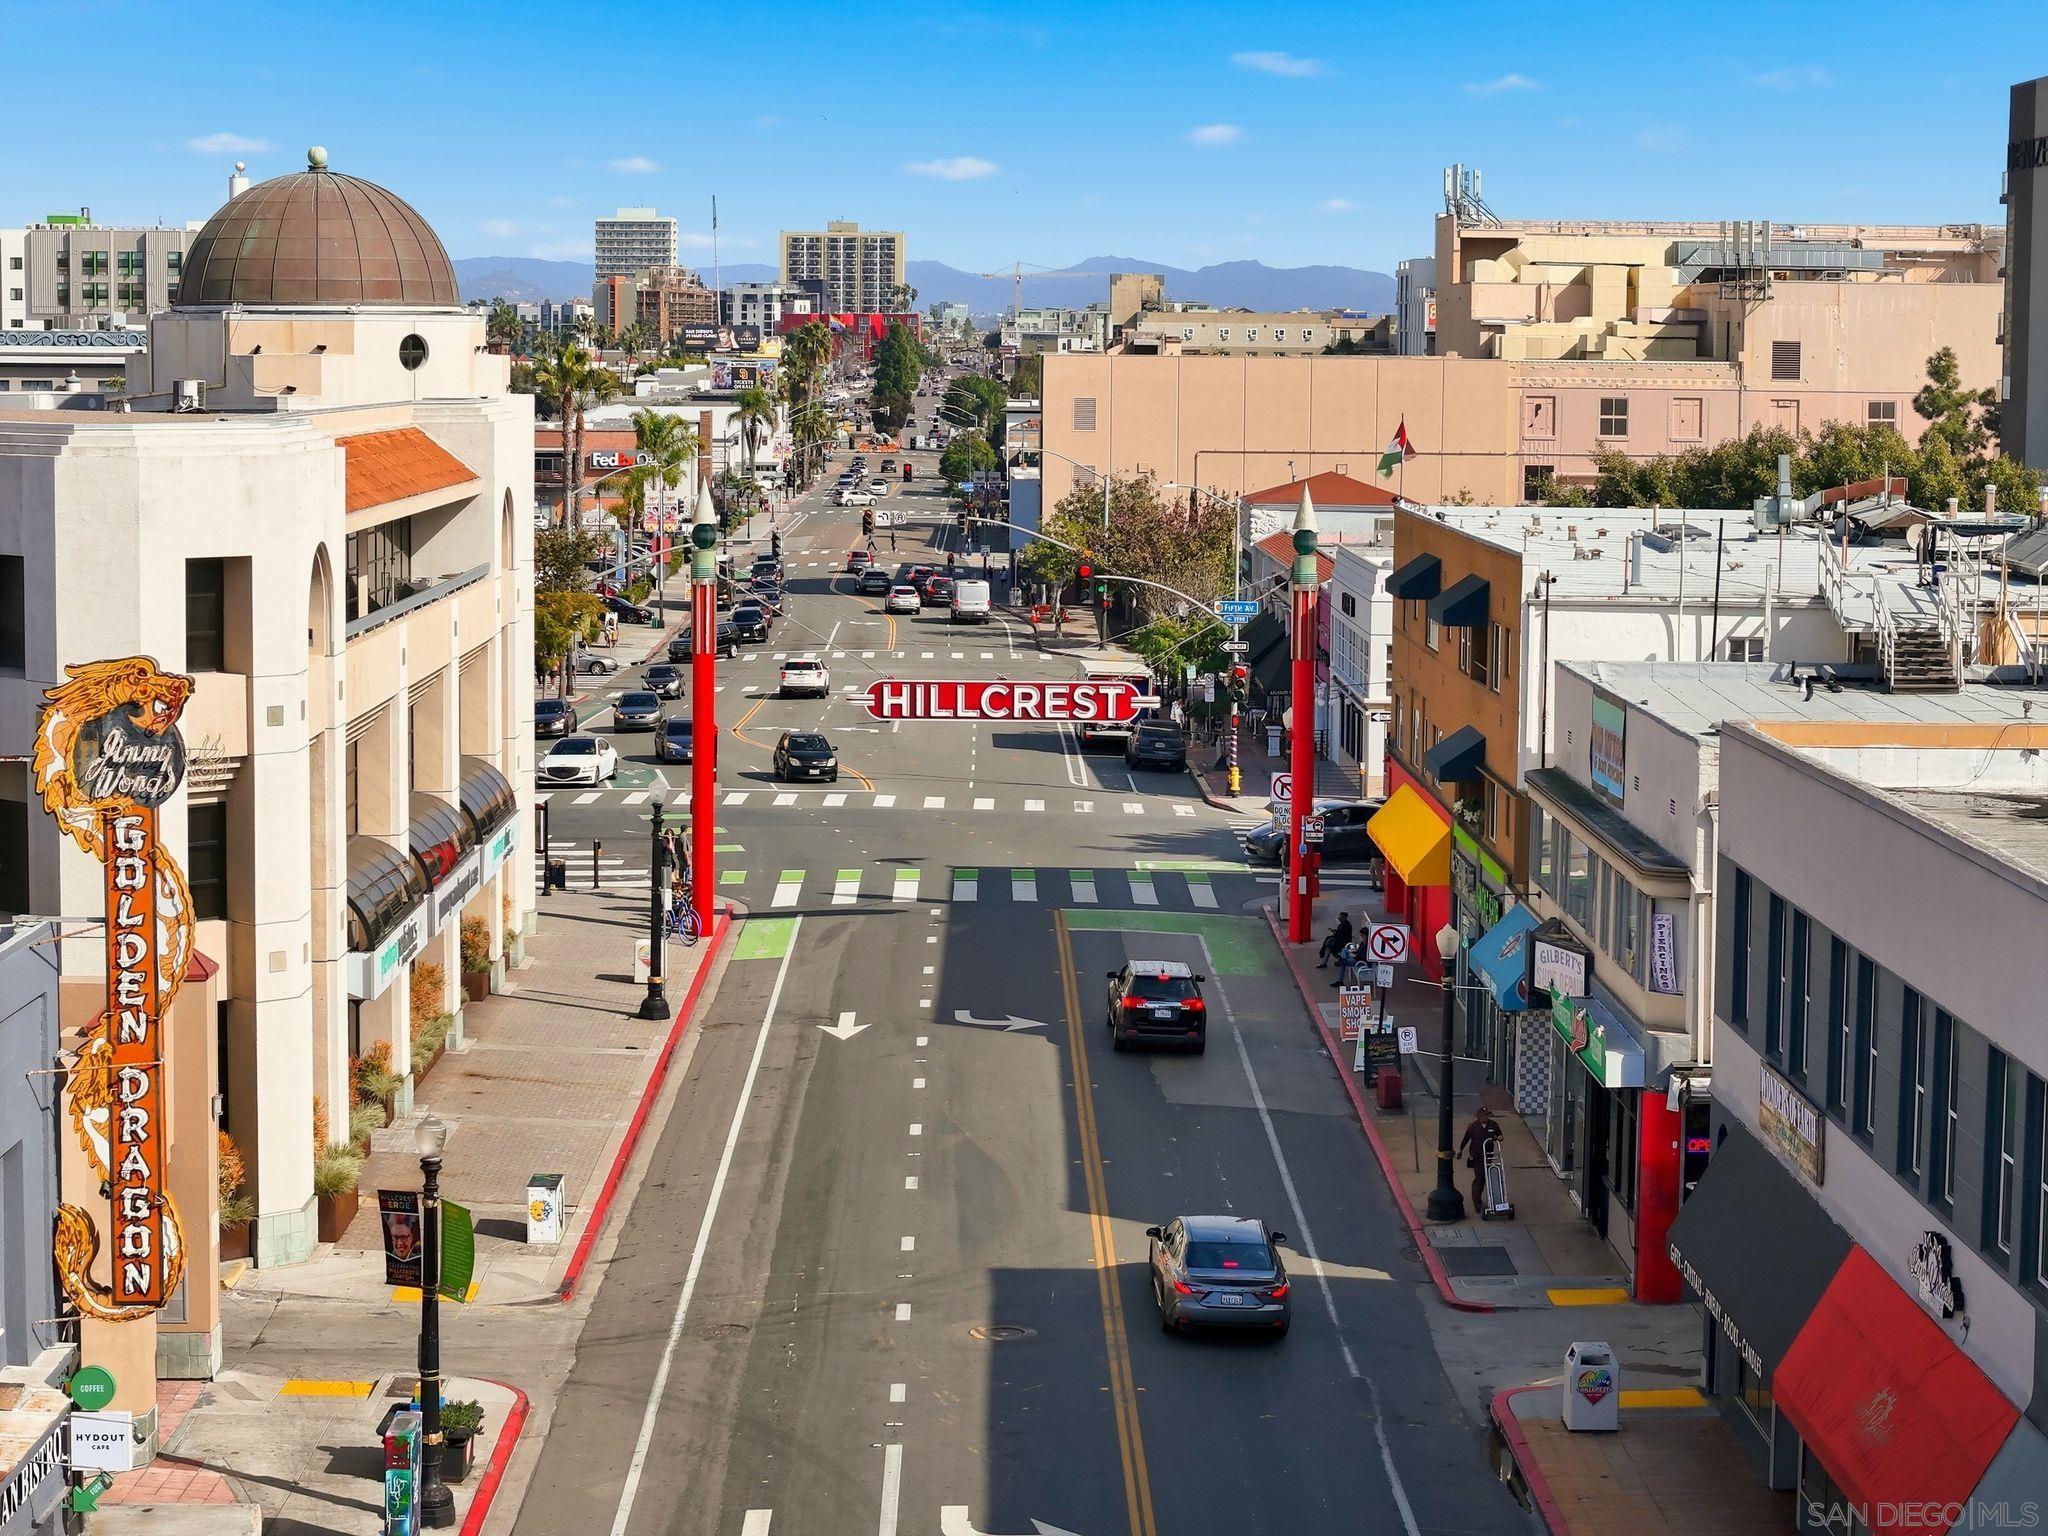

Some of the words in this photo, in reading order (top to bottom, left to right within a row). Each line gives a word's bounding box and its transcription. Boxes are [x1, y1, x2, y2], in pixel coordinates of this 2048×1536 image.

[592, 452, 635, 466] FedEx
[585, 516, 608, 524] GNC
[882, 684, 1126, 719] HILLCREST
[85, 726, 174, 781] Jimmy
[1274, 806, 1283, 814] DO
[1274, 816, 1292, 825] BLOC
[111, 815, 149, 1045] GOLDEN
[1540, 949, 1583, 976] GILBERT'S
[1345, 994, 1366, 1006] VAPE
[1341, 1006, 1371, 1018] SMOKE
[1345, 1018, 1361, 1030] SHO
[1688, 1138, 1711, 1151] OPE
[117, 1064, 151, 1296] DRAGON
[1669, 1243, 1682, 1269] GIFTS
[1723, 1312, 1740, 1348] BOOKS
[1741, 1338, 1763, 1379] CANDLES
[80, 1384, 105, 1393] COFFEE
[76, 1433, 125, 1442] HYDOUT
[21, 1426, 62, 1505] BISTRO
